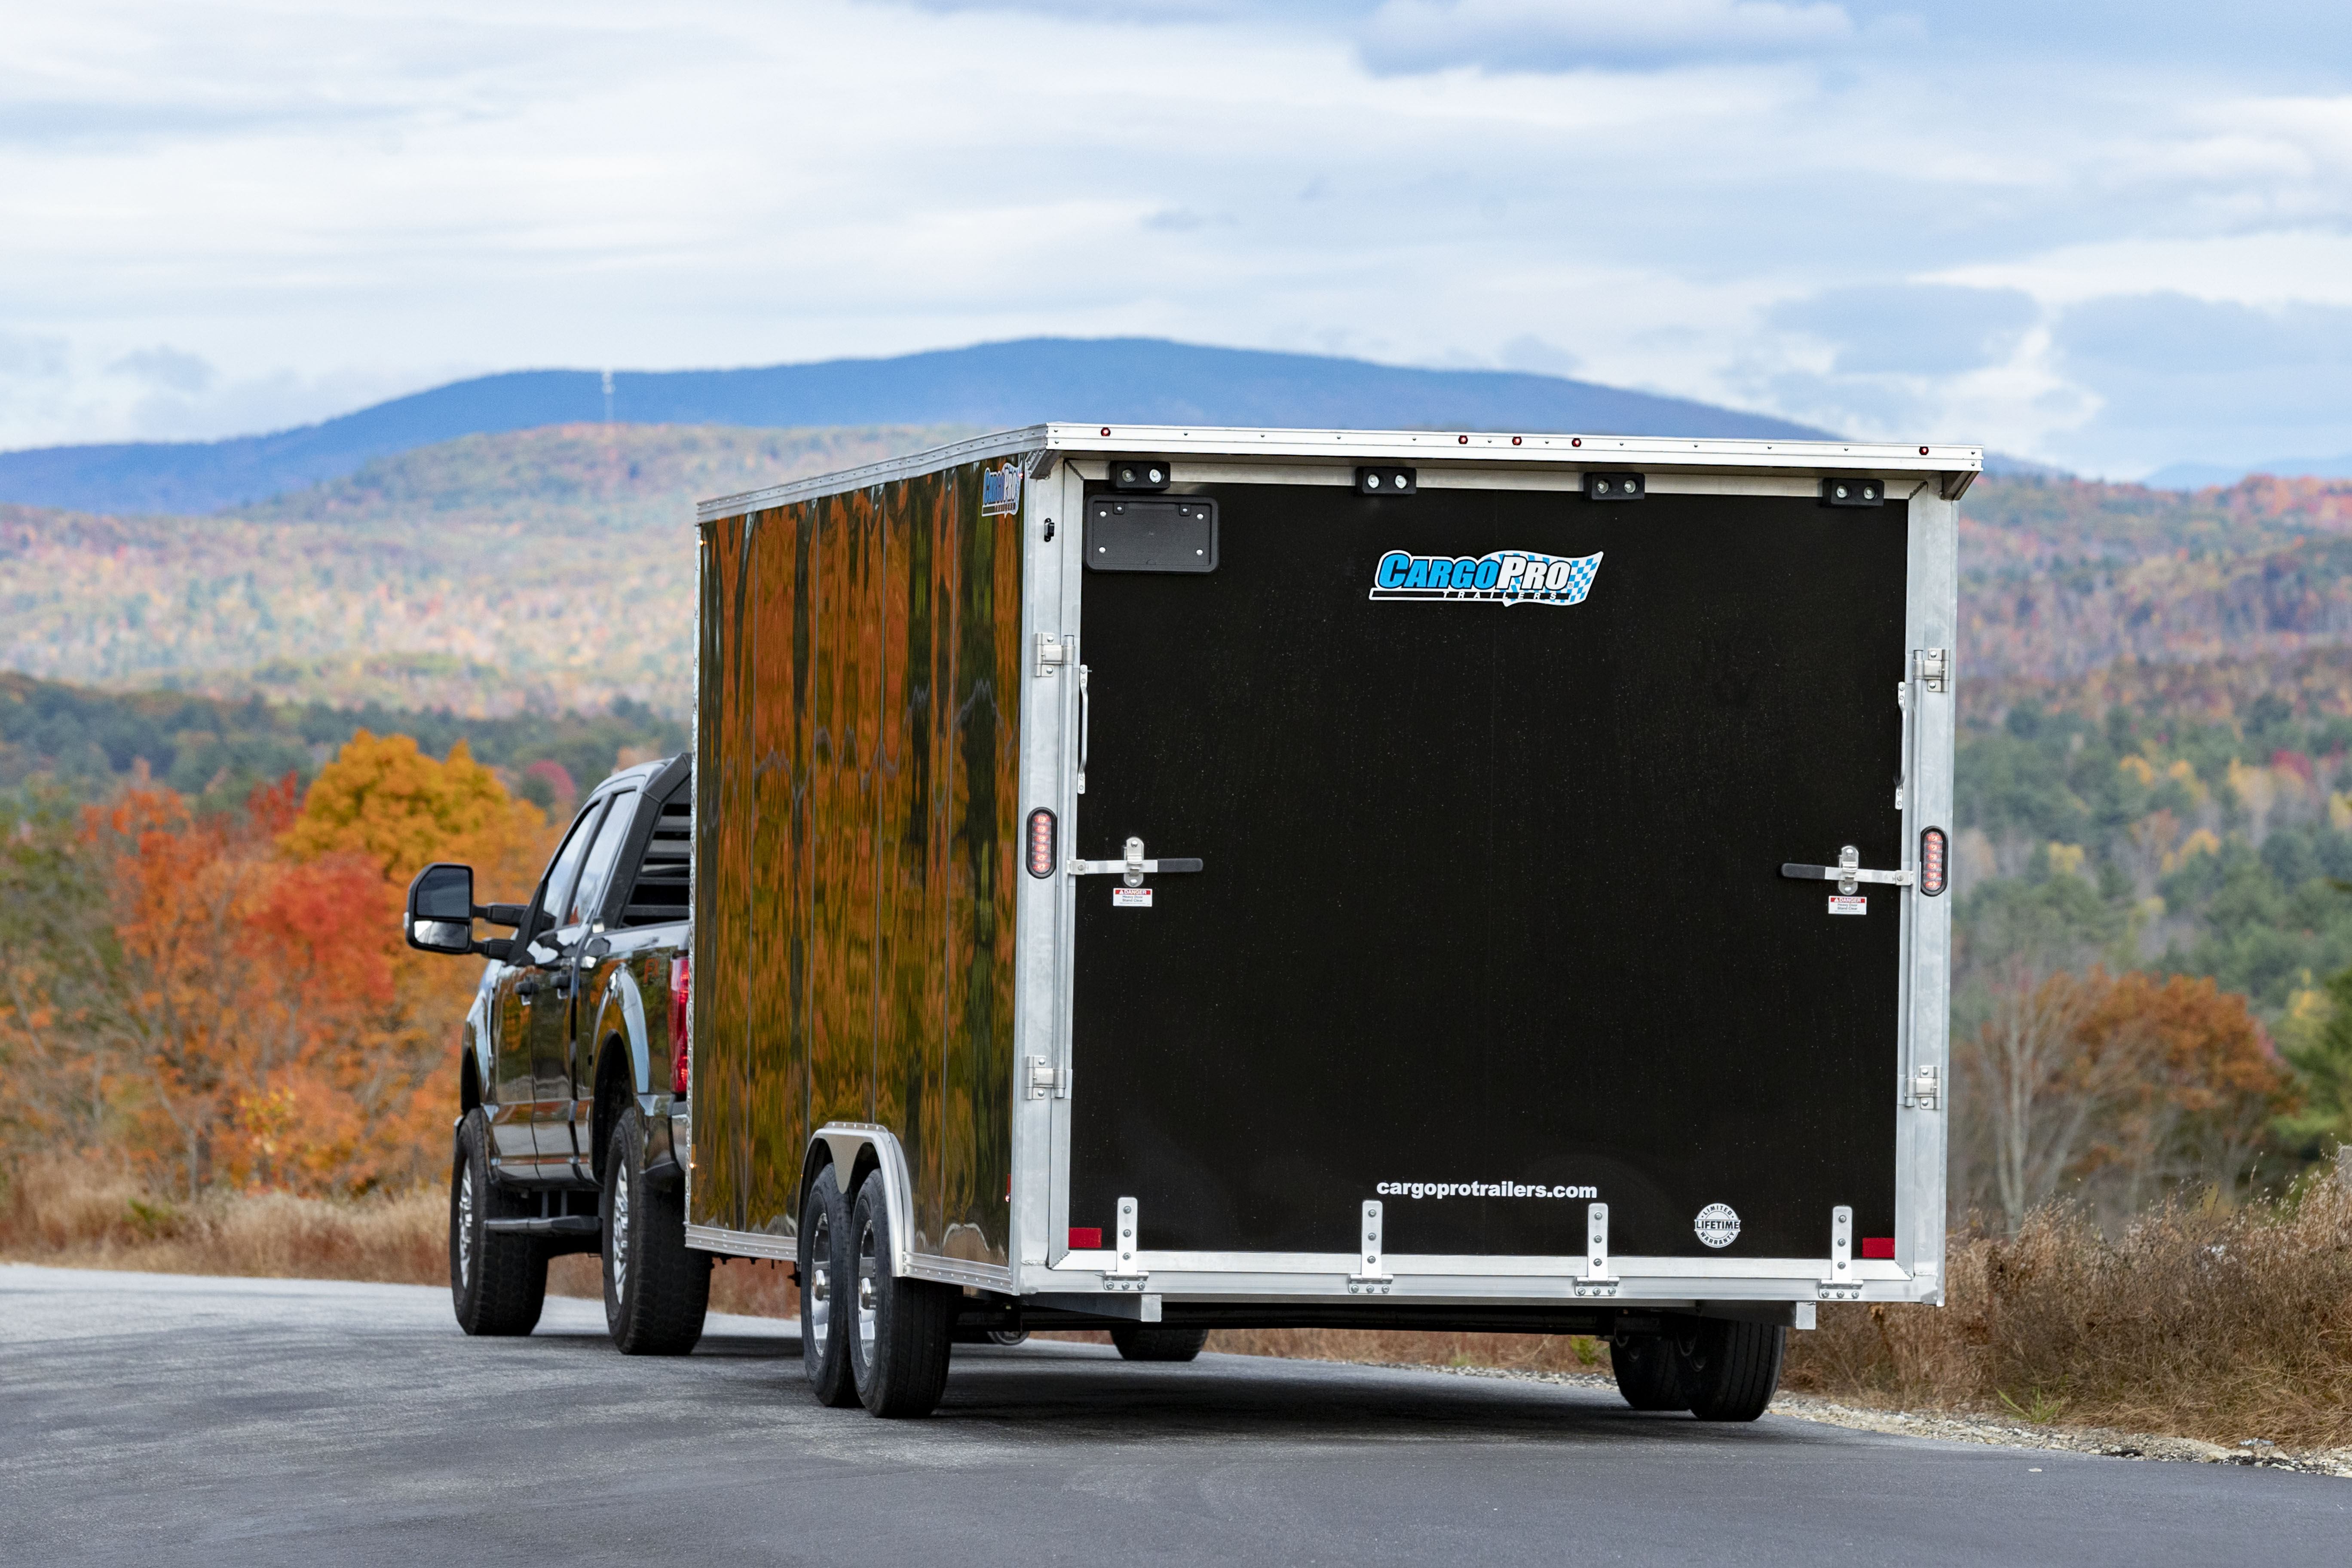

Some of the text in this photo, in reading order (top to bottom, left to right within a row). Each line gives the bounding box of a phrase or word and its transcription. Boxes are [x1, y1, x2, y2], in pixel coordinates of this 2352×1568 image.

[1443, 591, 1557, 600] TRAILERS
[1376, 1181, 1597, 1199] cargoprotrailers.com
[1703, 1205, 1733, 1215] LIMITED
[1696, 1221, 1740, 1229] LIFETIME
[1700, 1231, 1734, 1245] WARRANTY
